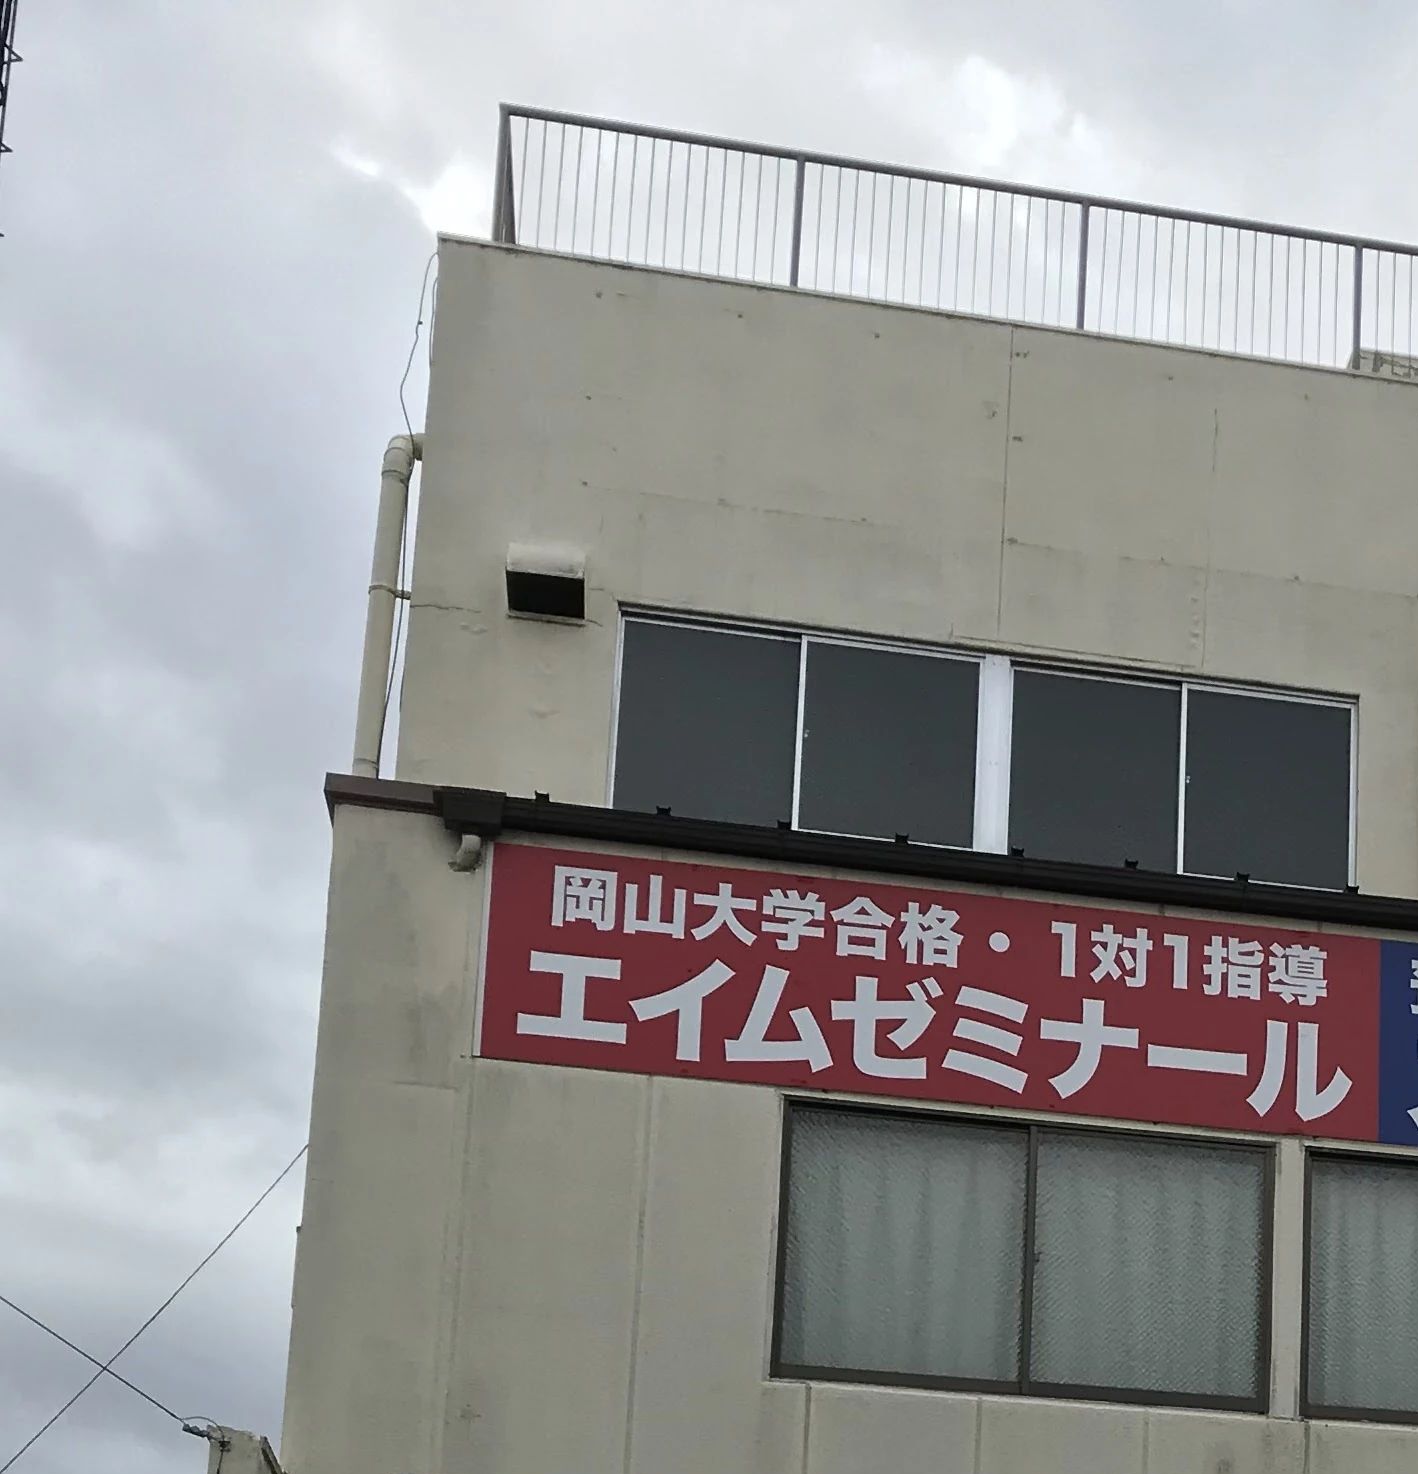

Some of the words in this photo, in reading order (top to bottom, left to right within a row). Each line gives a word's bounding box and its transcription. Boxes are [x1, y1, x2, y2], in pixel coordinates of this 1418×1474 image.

[515, 950, 1354, 1122] エイムゼミナール
